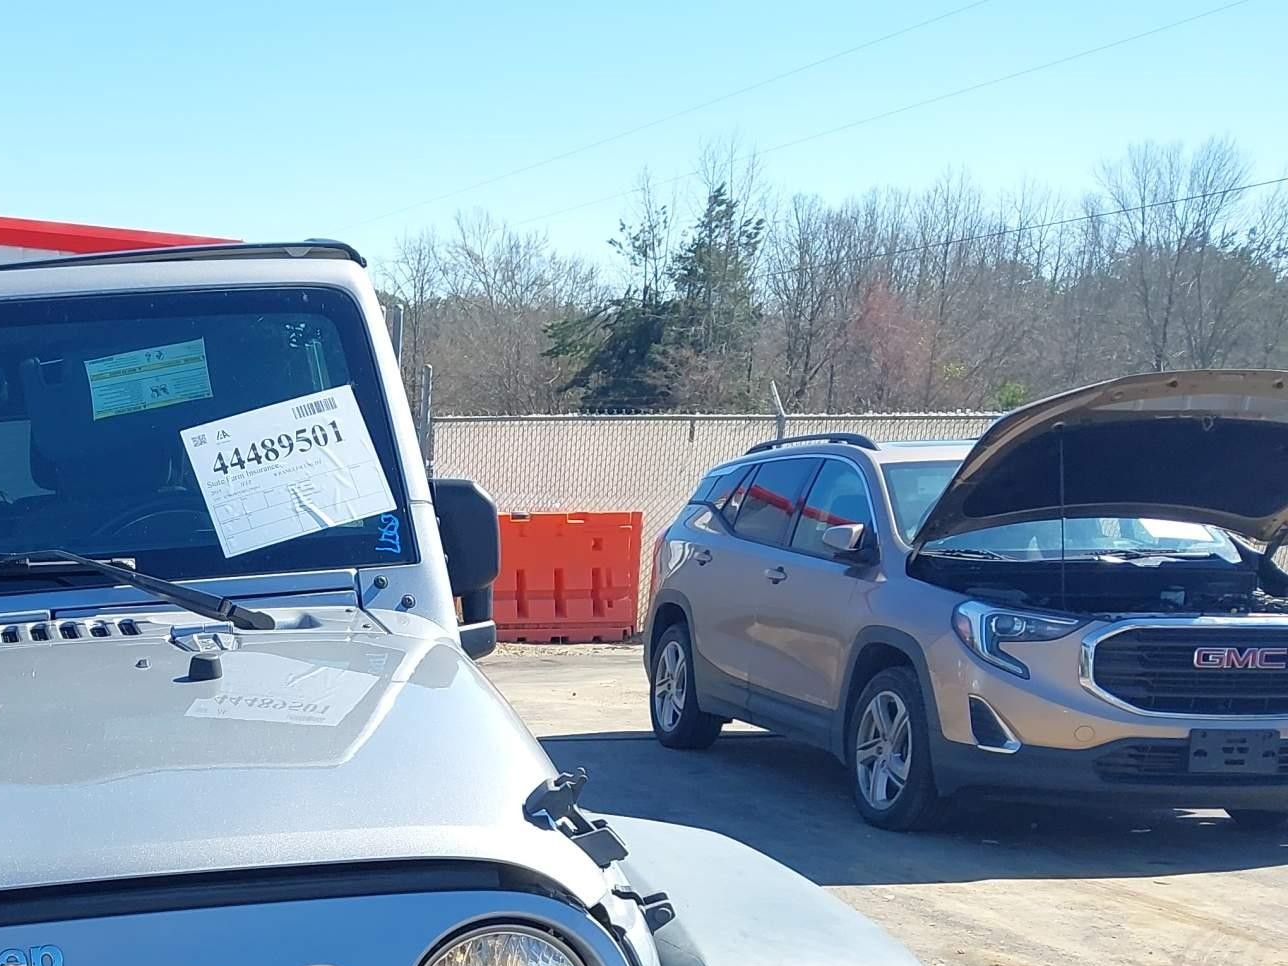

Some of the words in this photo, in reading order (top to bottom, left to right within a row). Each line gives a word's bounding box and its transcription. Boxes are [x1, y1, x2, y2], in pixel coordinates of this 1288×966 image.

[213, 420, 345, 475] 44489501
[206, 478, 226, 490] State
[225, 471, 245, 484] Farm
[1194, 647, 1288, 669] GMC
